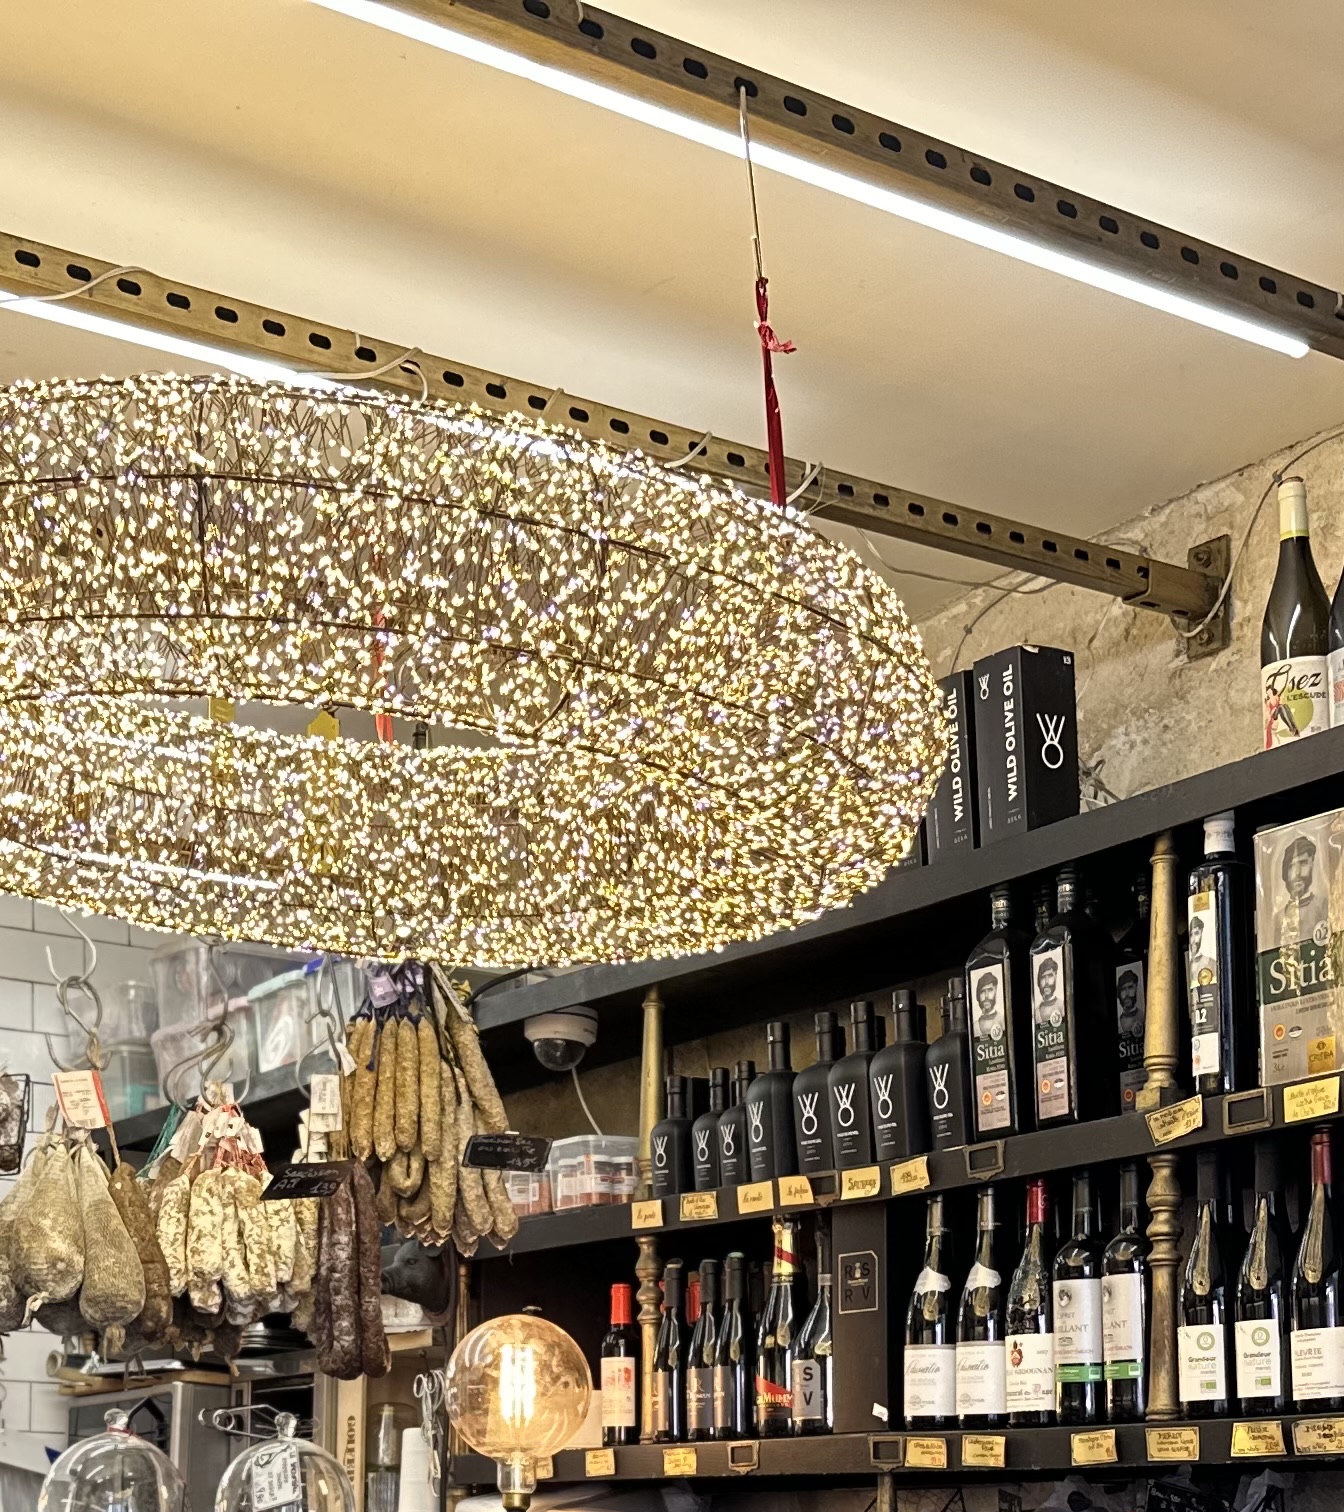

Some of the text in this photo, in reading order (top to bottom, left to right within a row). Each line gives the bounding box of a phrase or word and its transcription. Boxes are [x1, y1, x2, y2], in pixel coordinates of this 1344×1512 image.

[947, 688, 964, 823] WILD OLIVE OIL
[1003, 664, 1018, 802] WILD OLIVE OIL
[1269, 950, 1334, 996] Sitia
[976, 1041, 1005, 1061] Sitia
[1037, 1028, 1065, 1048] Sitia
